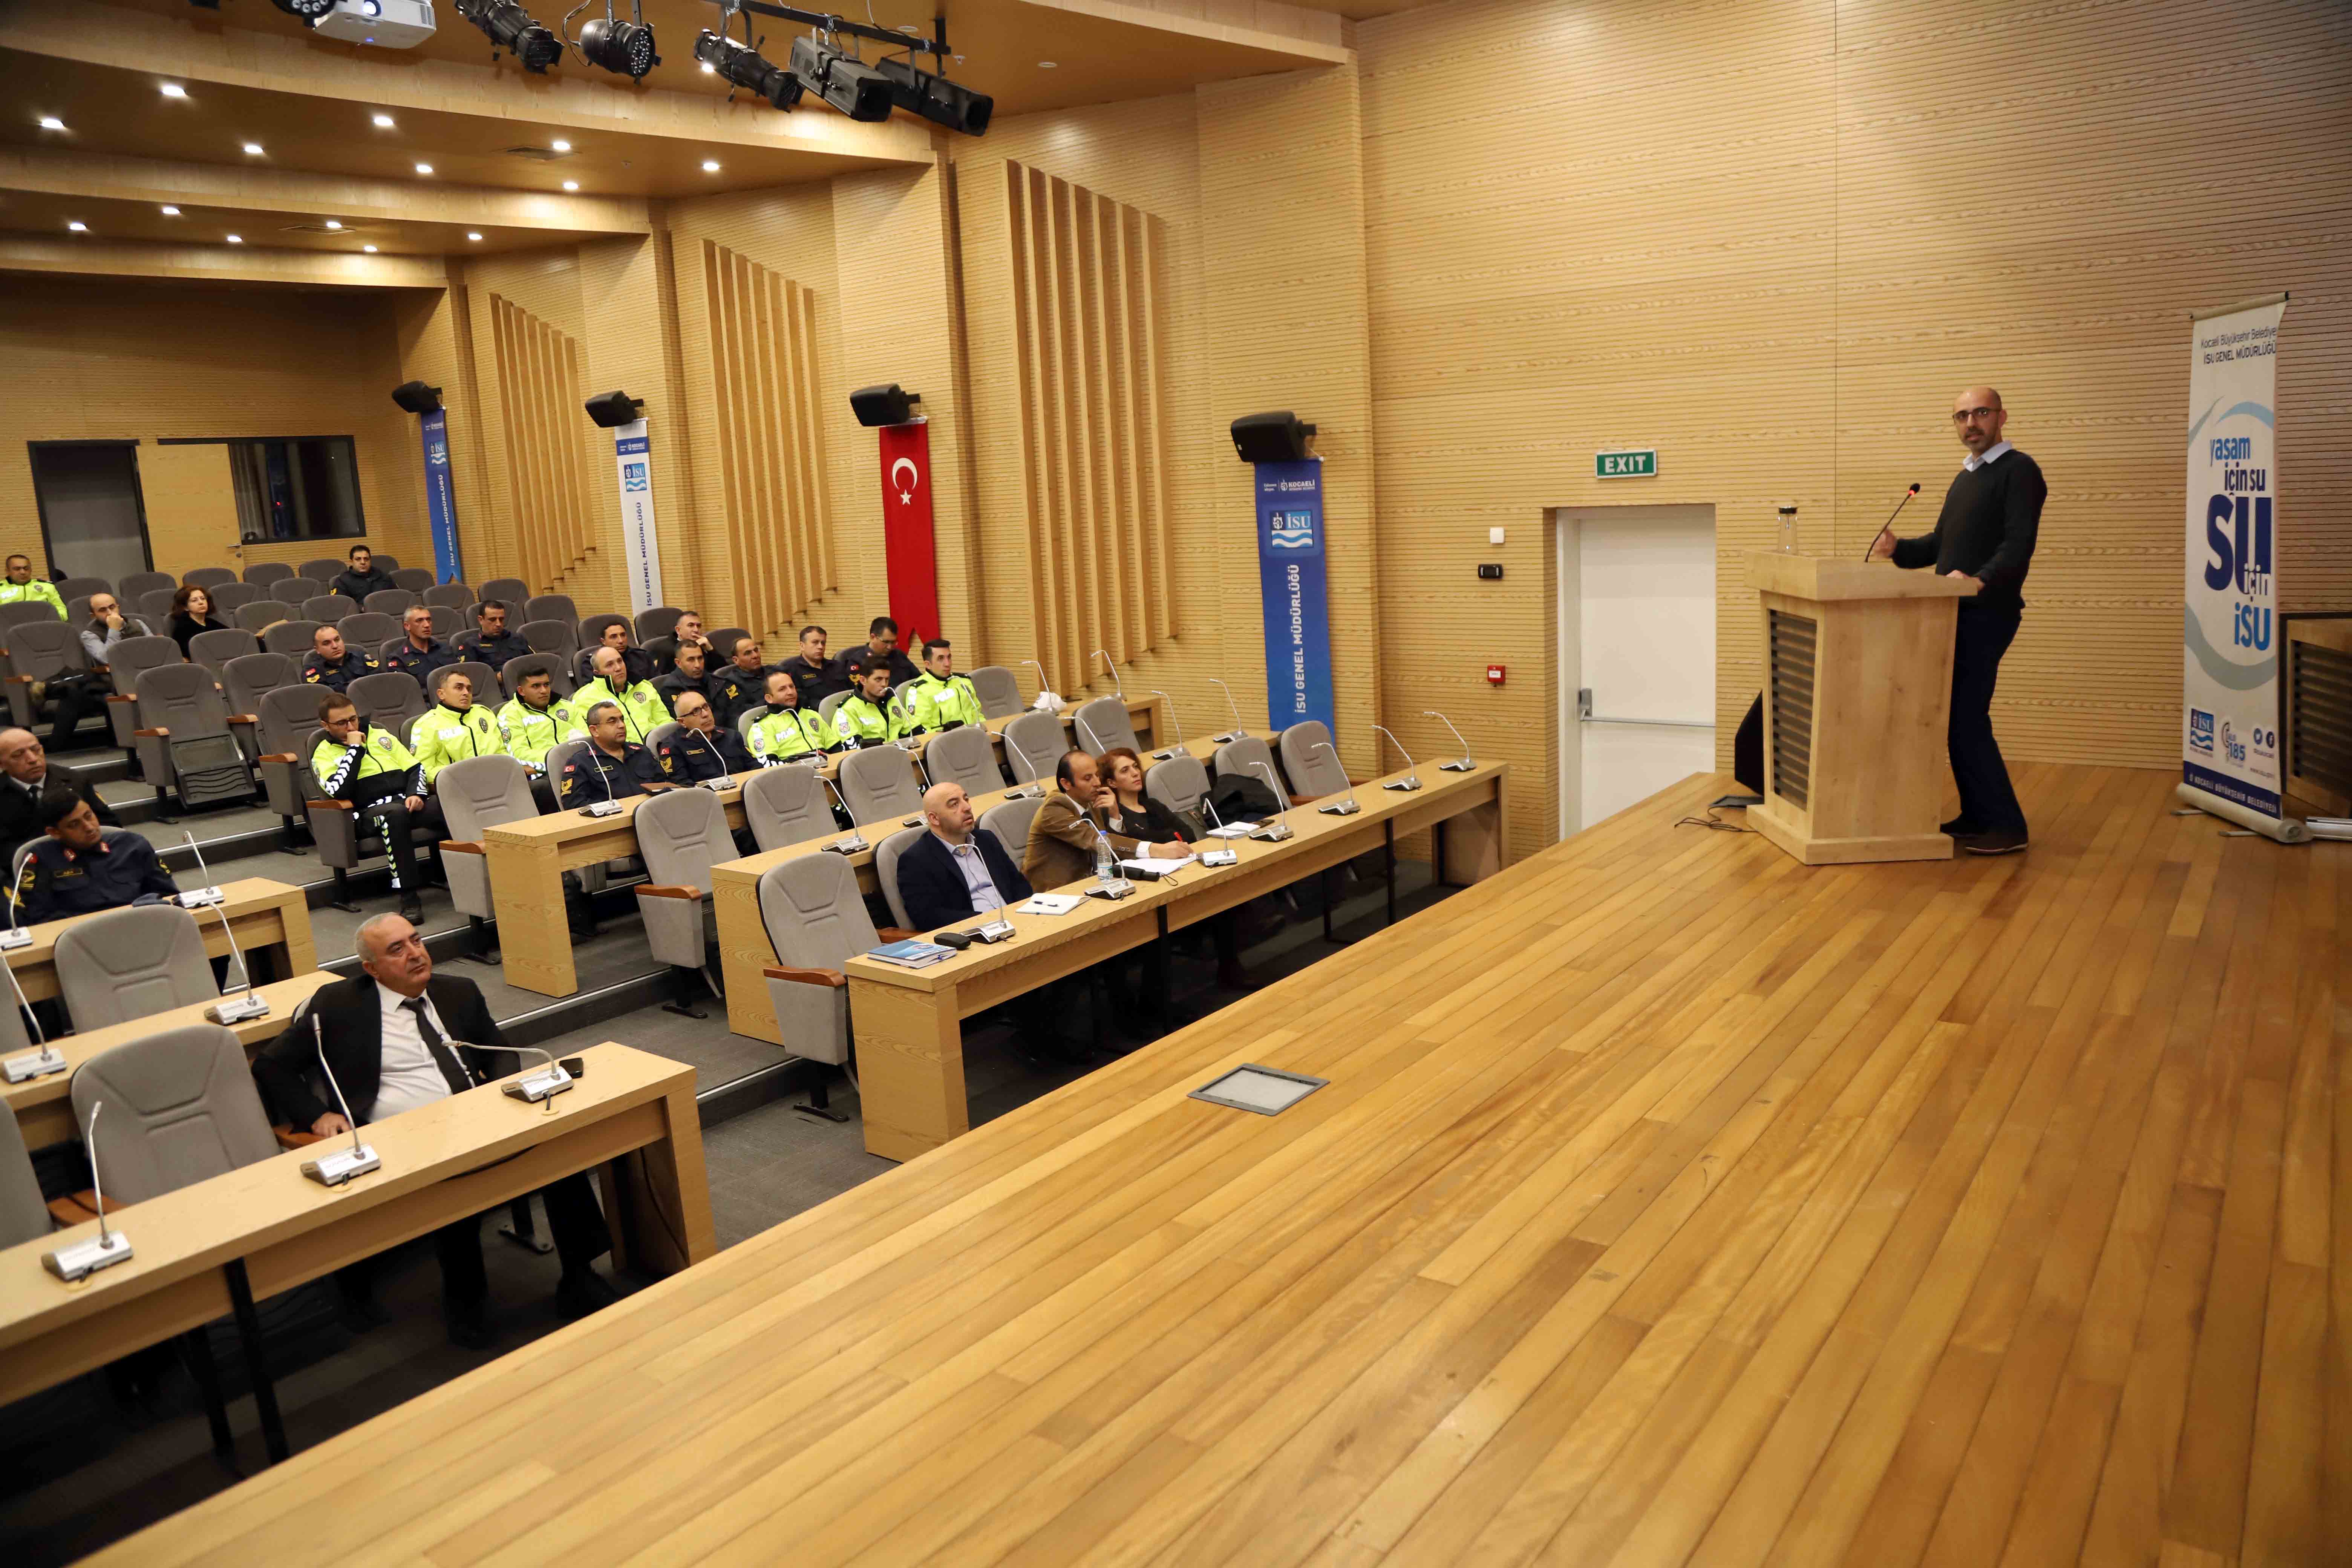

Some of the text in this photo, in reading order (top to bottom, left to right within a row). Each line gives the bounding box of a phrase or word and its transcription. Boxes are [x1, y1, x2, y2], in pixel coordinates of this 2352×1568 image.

[2216, 349, 2234, 363] GENEL
[2236, 340, 2277, 359] MÜDÜRLÜĞÜ
[1605, 456, 1646, 473] EXIT
[636, 502, 646, 557] MÜDÜRLÜĞÜ
[1286, 514, 1310, 528] İSU
[643, 561, 652, 589] GENEL
[1288, 565, 1306, 713] İSU GENEL MÜDÜRLÜĞÜ
[2230, 742, 2245, 761] 185
